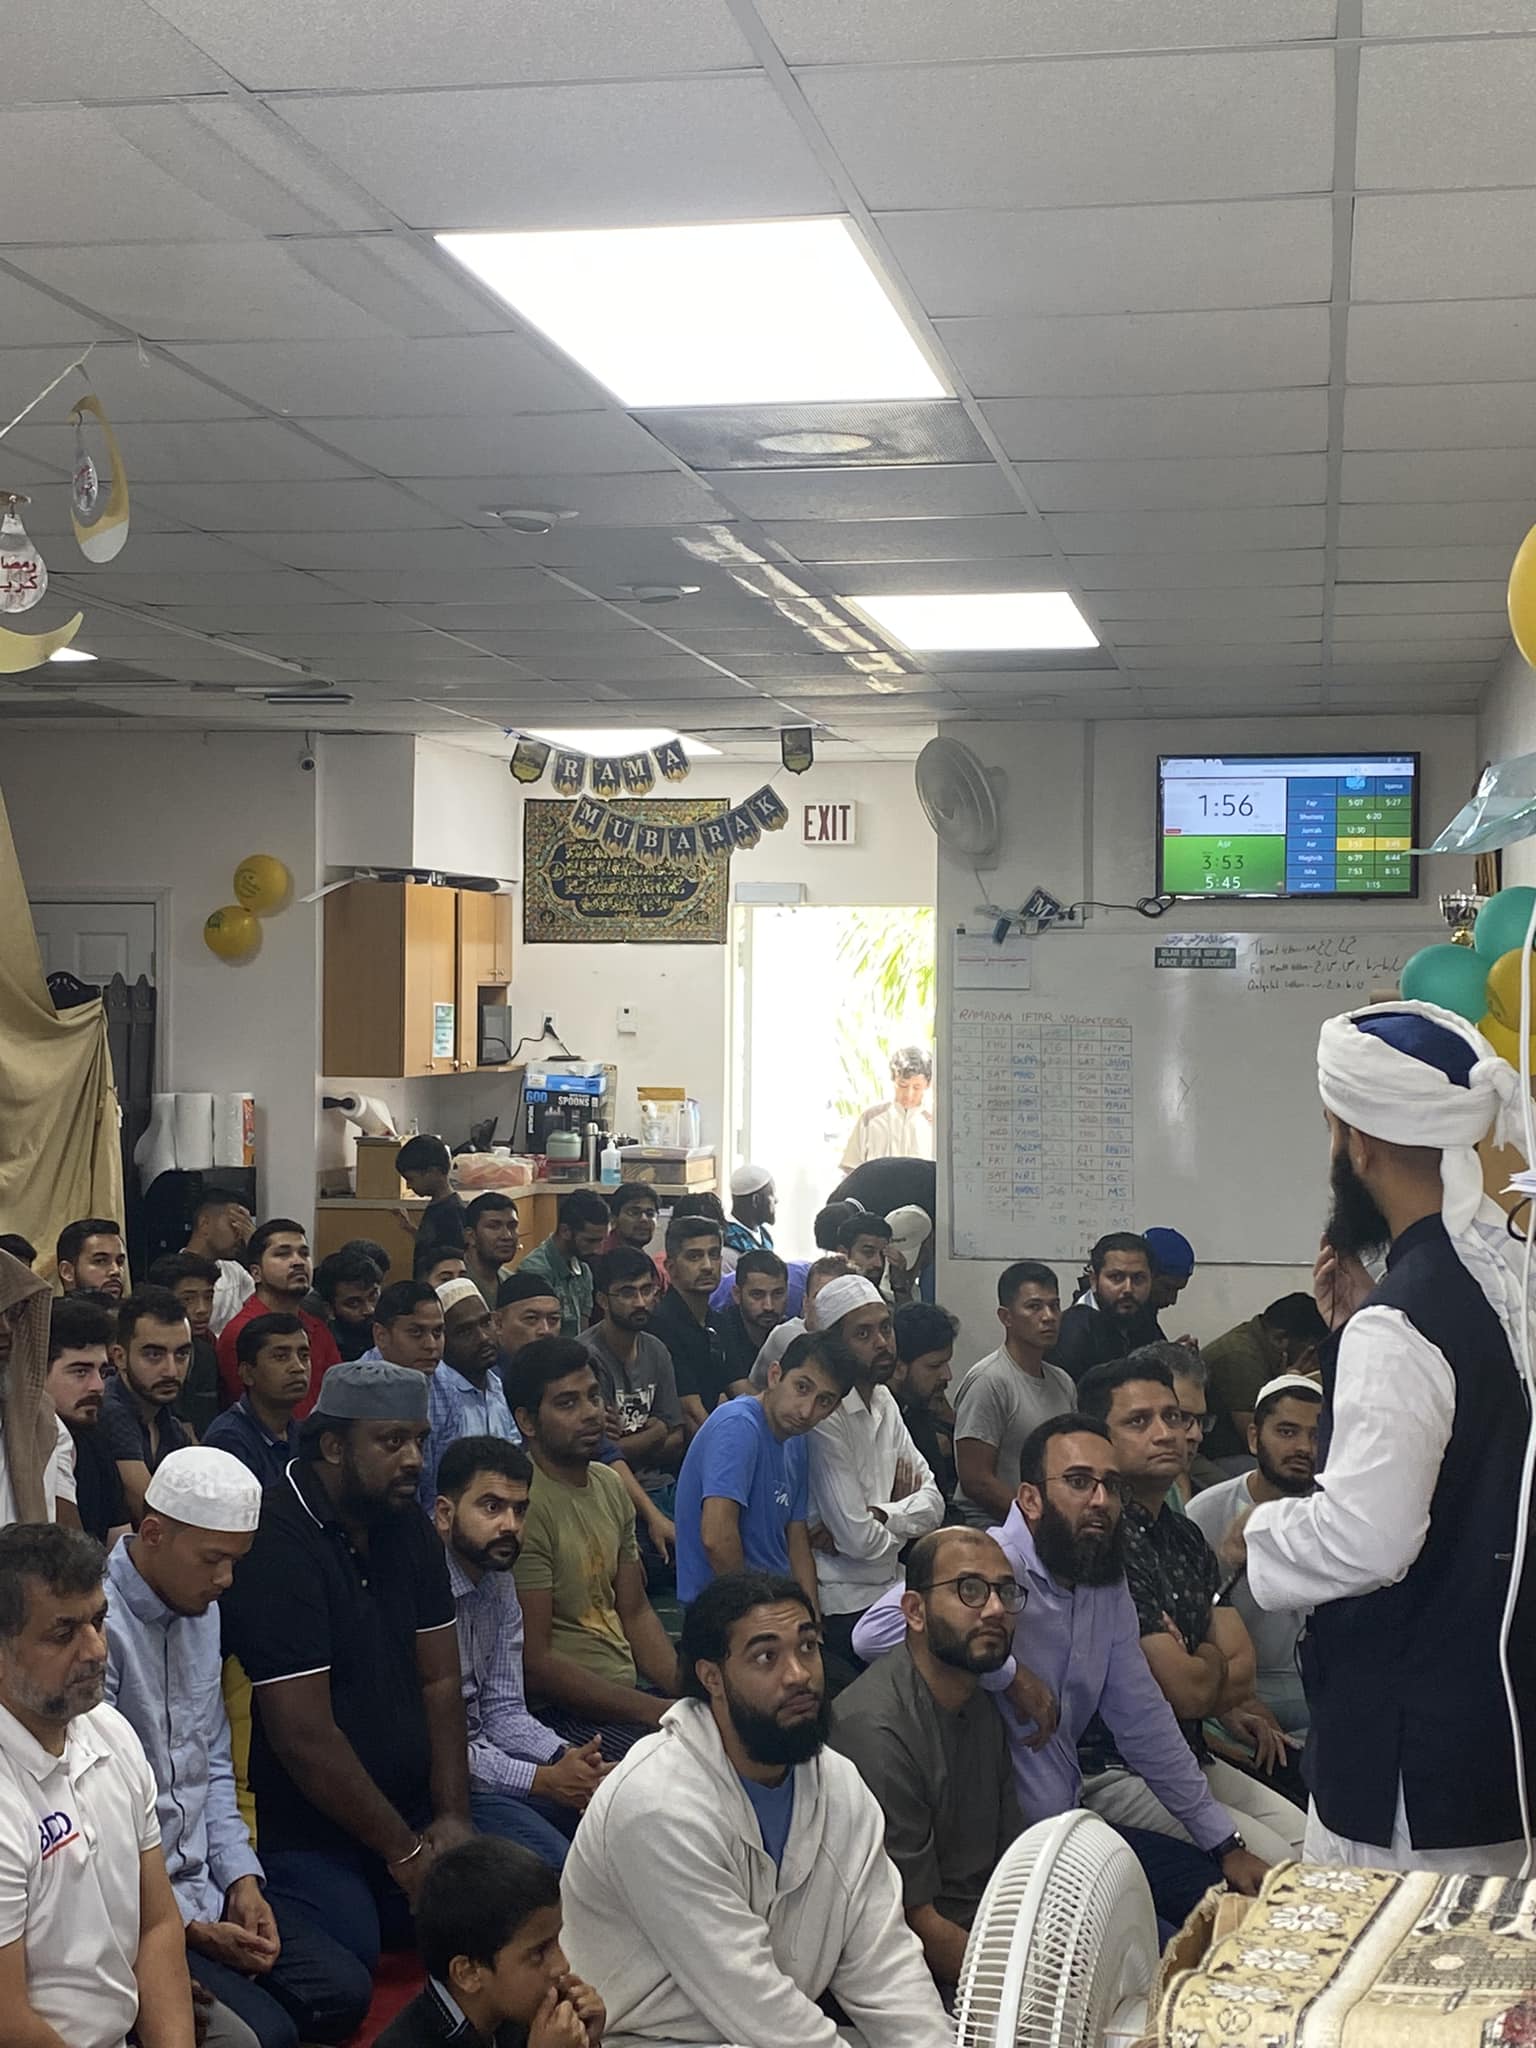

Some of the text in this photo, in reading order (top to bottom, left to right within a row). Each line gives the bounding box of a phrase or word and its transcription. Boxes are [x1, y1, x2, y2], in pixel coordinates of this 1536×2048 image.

[1198, 794, 1254, 817] 1:56
[580, 797, 777, 850] MUBARAK
[804, 805, 851, 841] EXIT
[1217, 840, 1233, 848] Asr
[1202, 855, 1244, 870] 3:53
[1205, 876, 1241, 889] 5:45
[1021, 1011, 1053, 1023] IFTAR
[526, 1091, 548, 1104] 600
[558, 1095, 591, 1108] SPOONS
